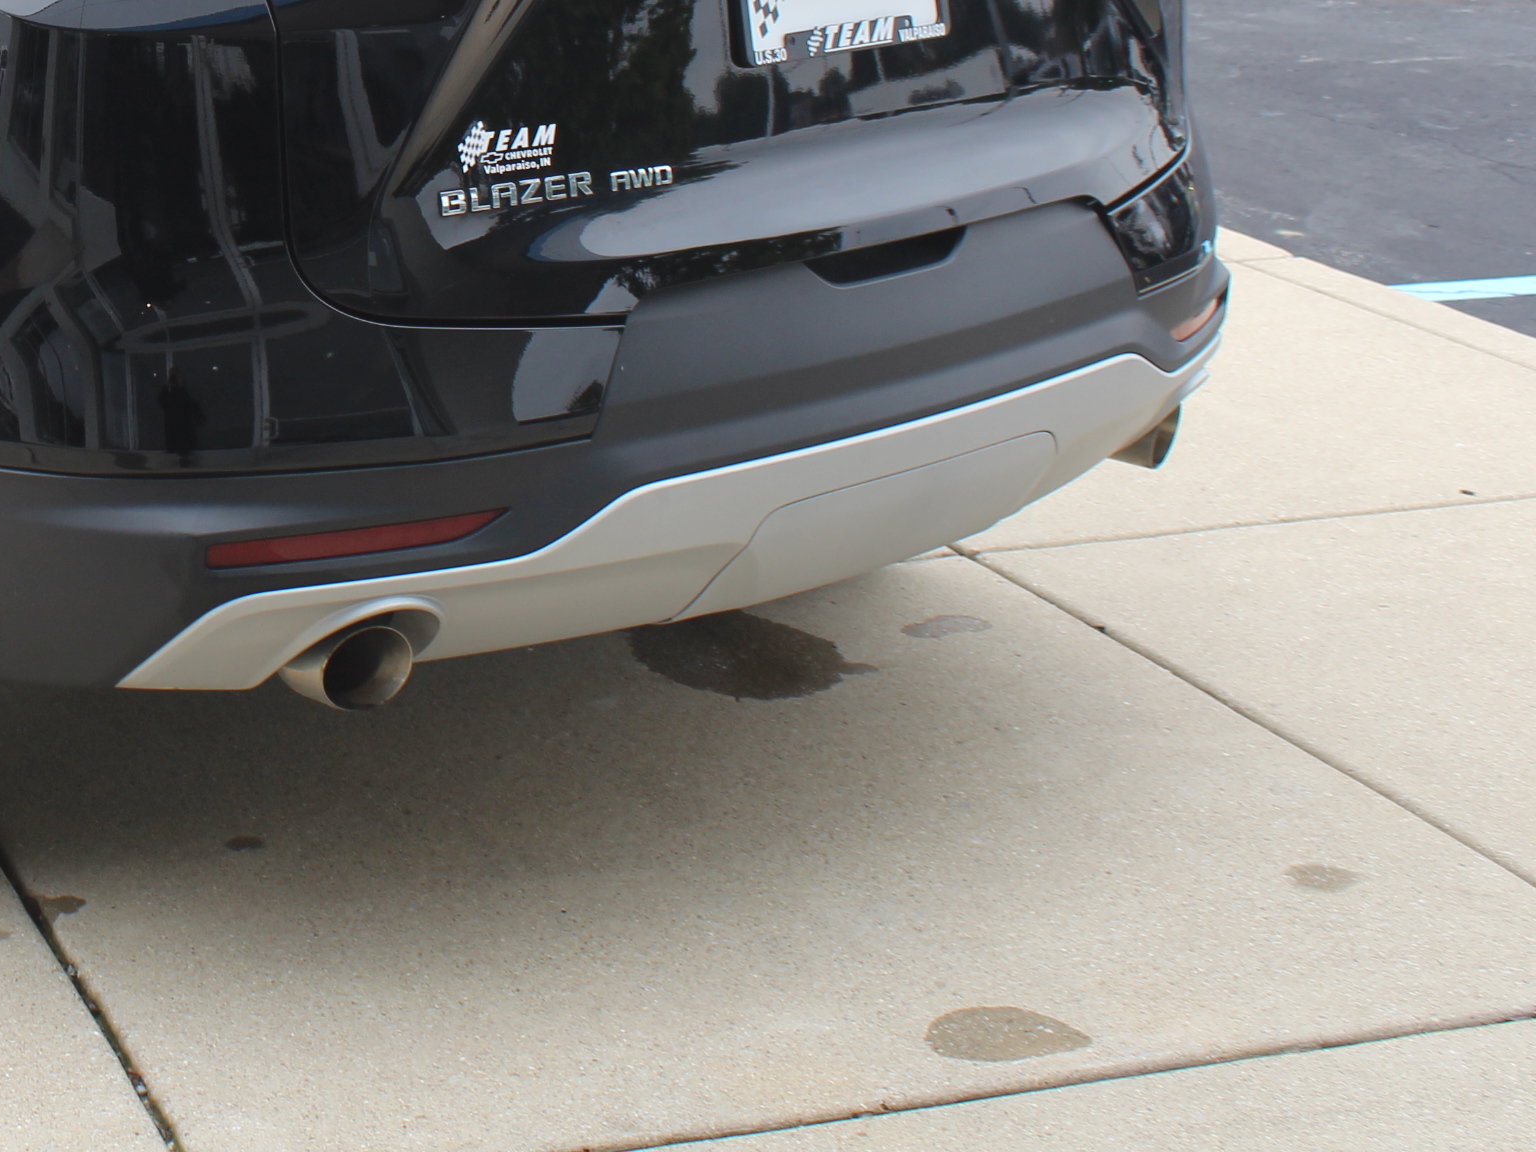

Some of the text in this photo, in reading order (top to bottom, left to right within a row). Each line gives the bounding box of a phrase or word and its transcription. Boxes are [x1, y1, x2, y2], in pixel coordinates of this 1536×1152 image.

[824, 16, 895, 53] TEAM
[484, 124, 557, 153] TEAM
[504, 147, 554, 161] CHEVROLET
[440, 165, 674, 217] BLAZER AWD
